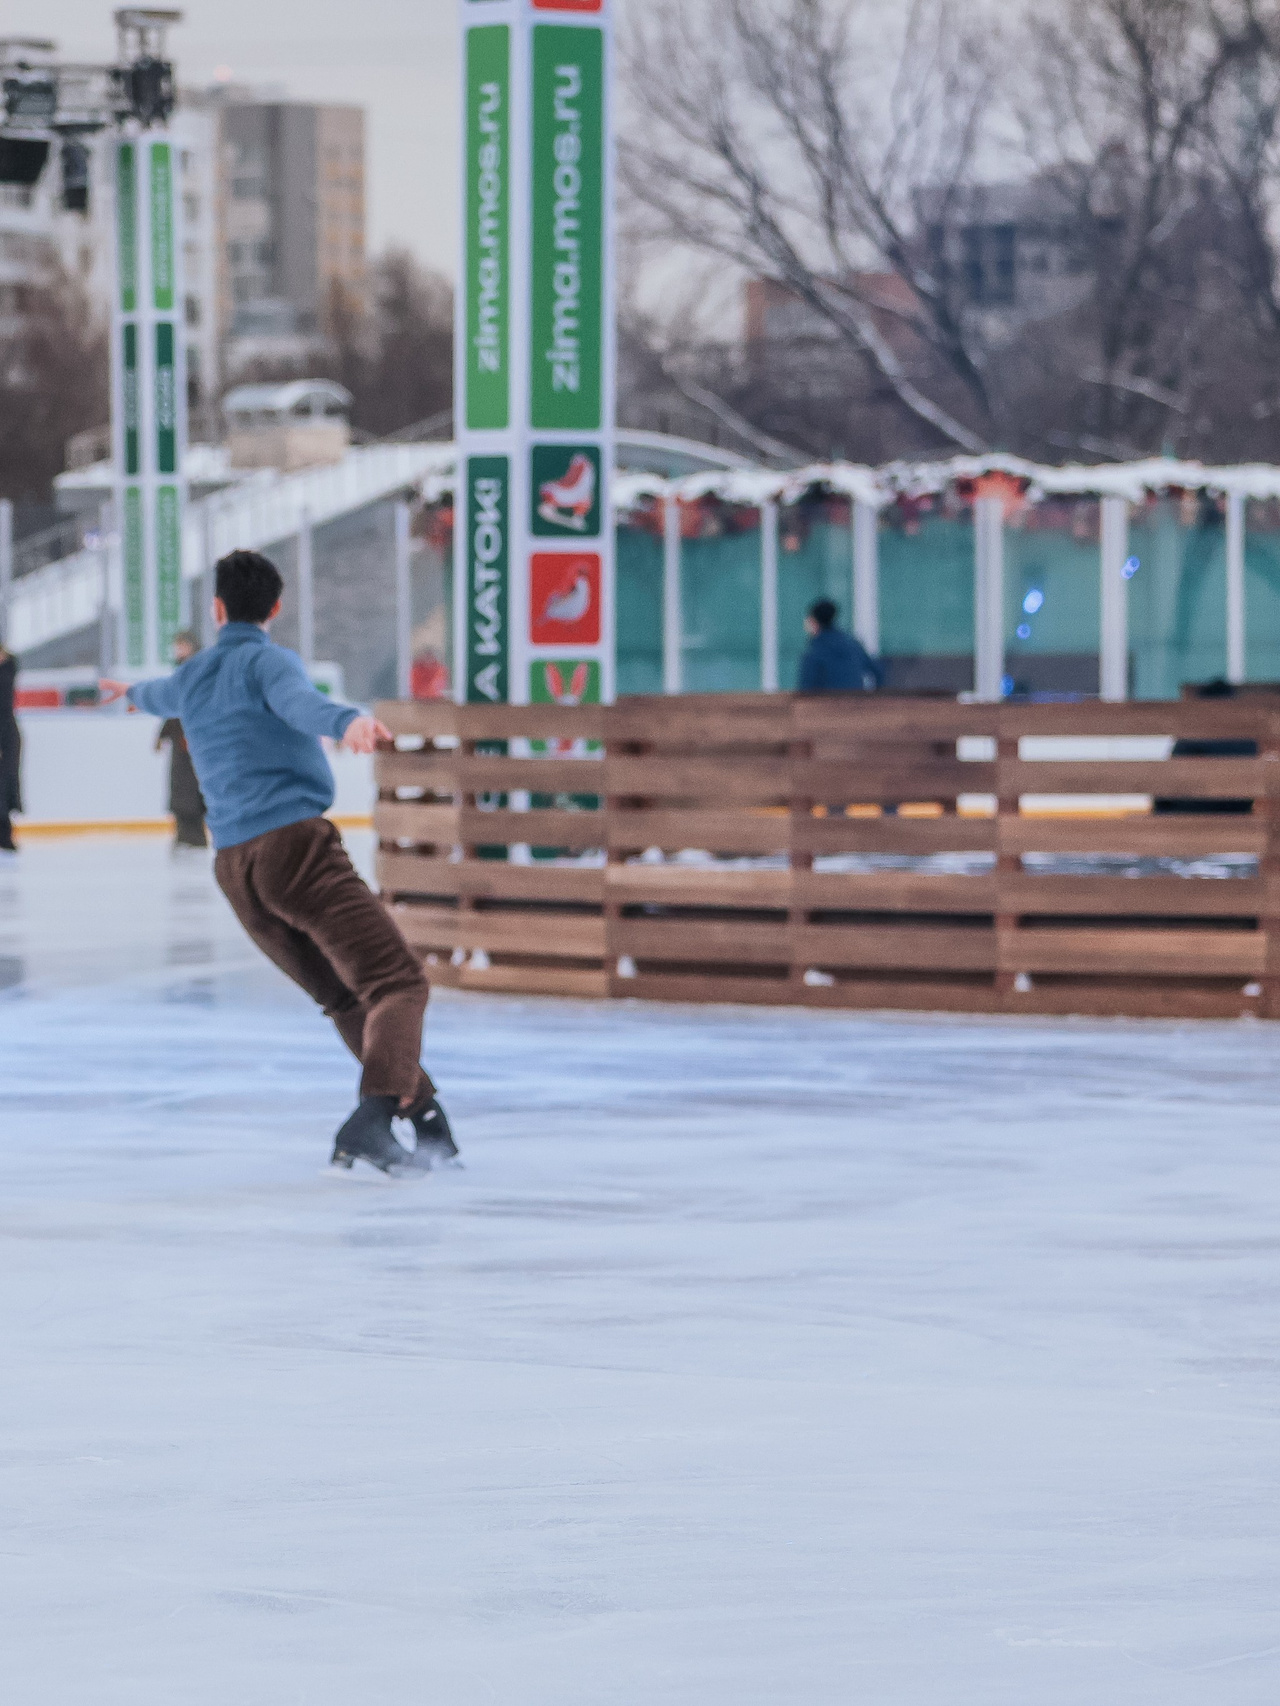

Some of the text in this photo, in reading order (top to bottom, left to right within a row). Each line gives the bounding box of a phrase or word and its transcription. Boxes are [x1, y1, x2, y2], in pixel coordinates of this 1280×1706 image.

[474, 82, 501, 373] zima.mos.ru
[545, 64, 583, 392] zima.mos.ru
[474, 476, 502, 702] А КАТОК!
